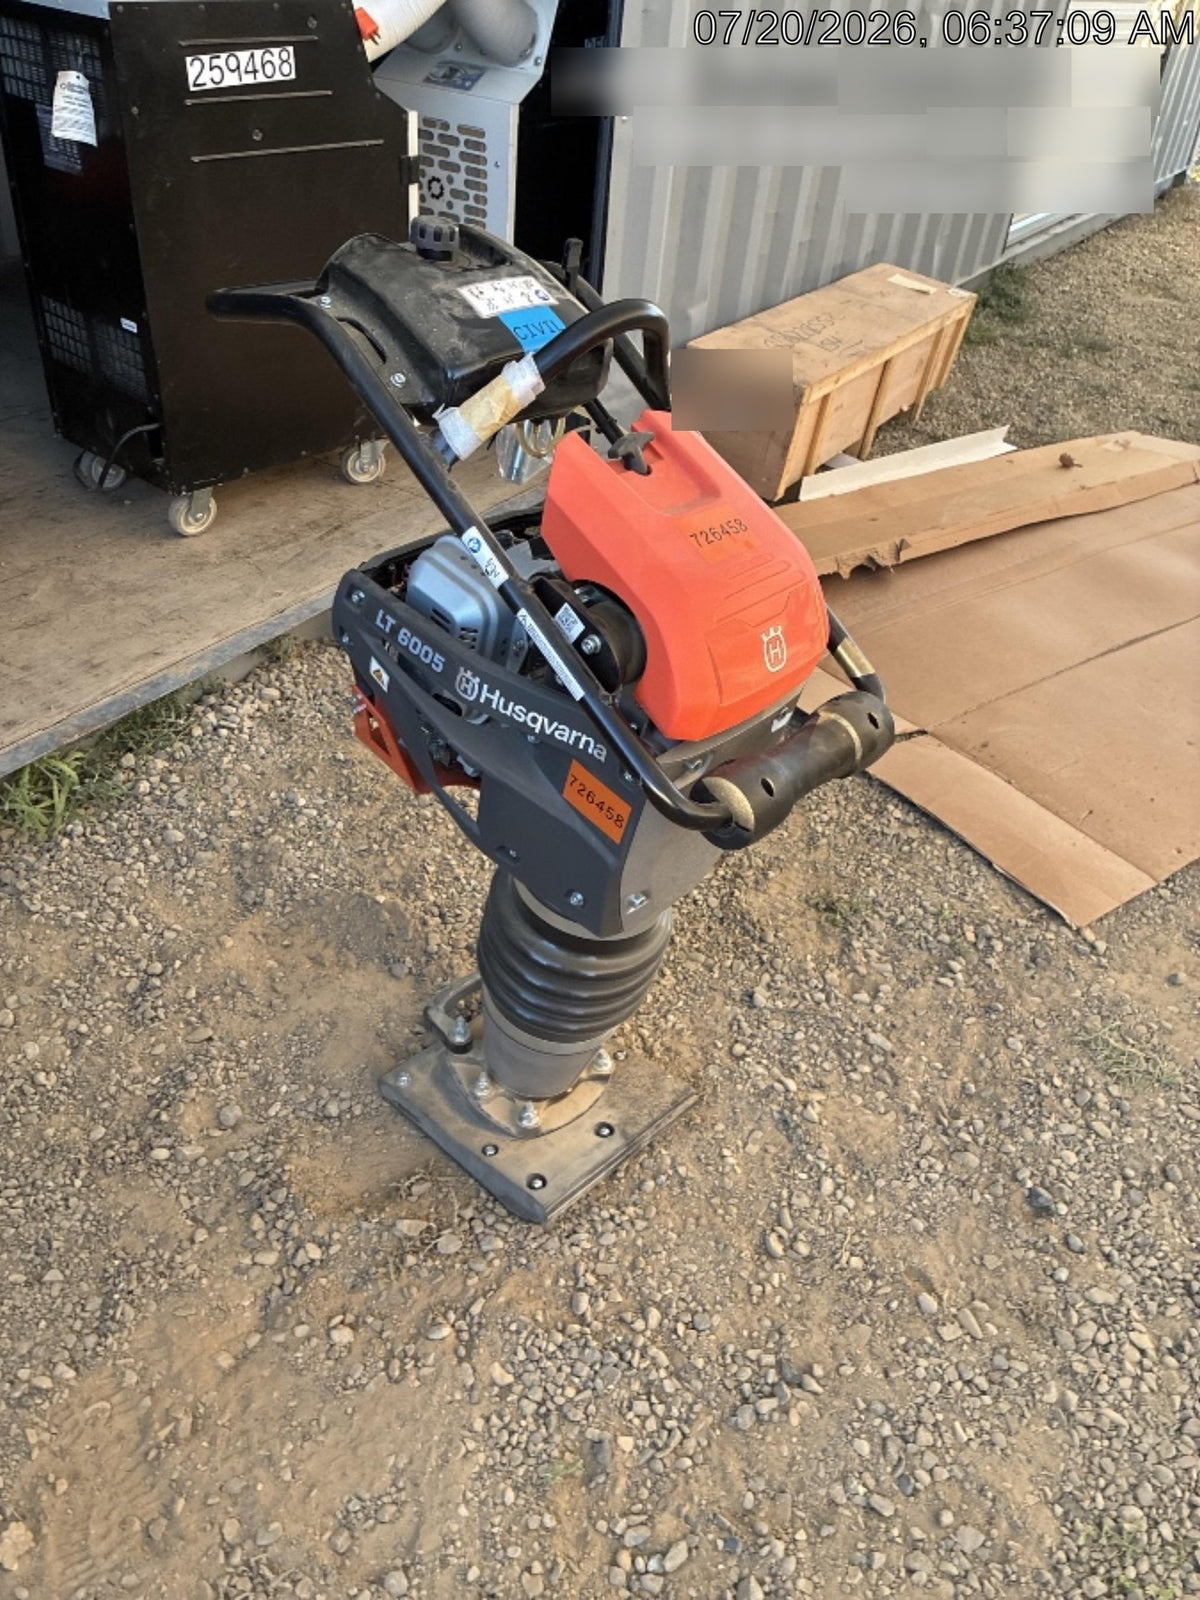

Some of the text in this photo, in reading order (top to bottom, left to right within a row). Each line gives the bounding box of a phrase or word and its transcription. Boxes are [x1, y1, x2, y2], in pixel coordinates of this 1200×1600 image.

[190, 47, 292, 87] 259468
[689, 517, 749, 548] 726458
[375, 609, 445, 673] LT 6005
[479, 684, 608, 764] Husqvarna
[569, 773, 625, 829] 726458
